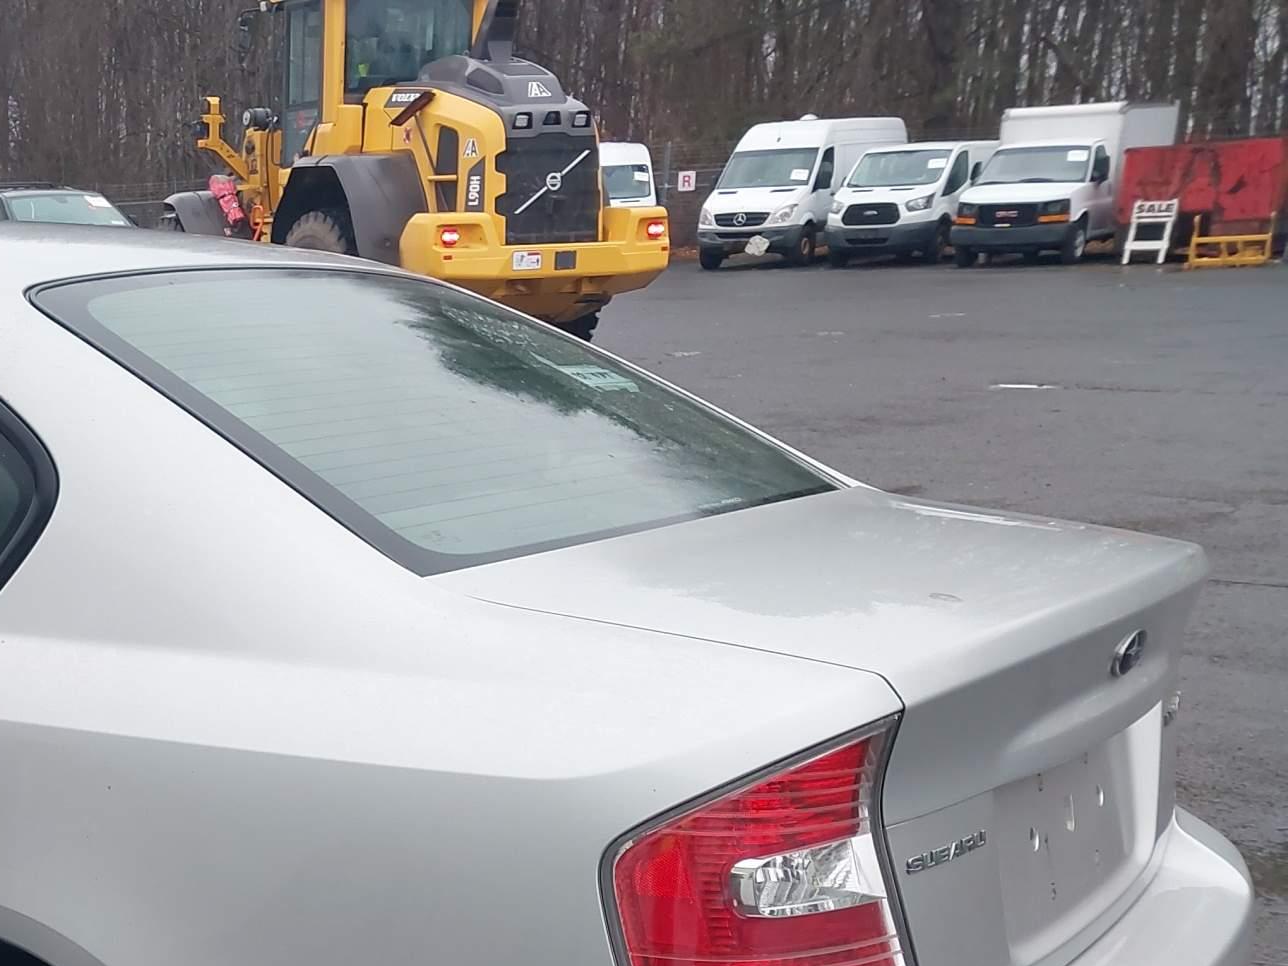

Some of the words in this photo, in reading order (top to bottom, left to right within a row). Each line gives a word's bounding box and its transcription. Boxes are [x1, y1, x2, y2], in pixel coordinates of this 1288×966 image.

[683, 175, 691, 188] R
[467, 175, 481, 206] L90H
[1135, 203, 1175, 214] SALE
